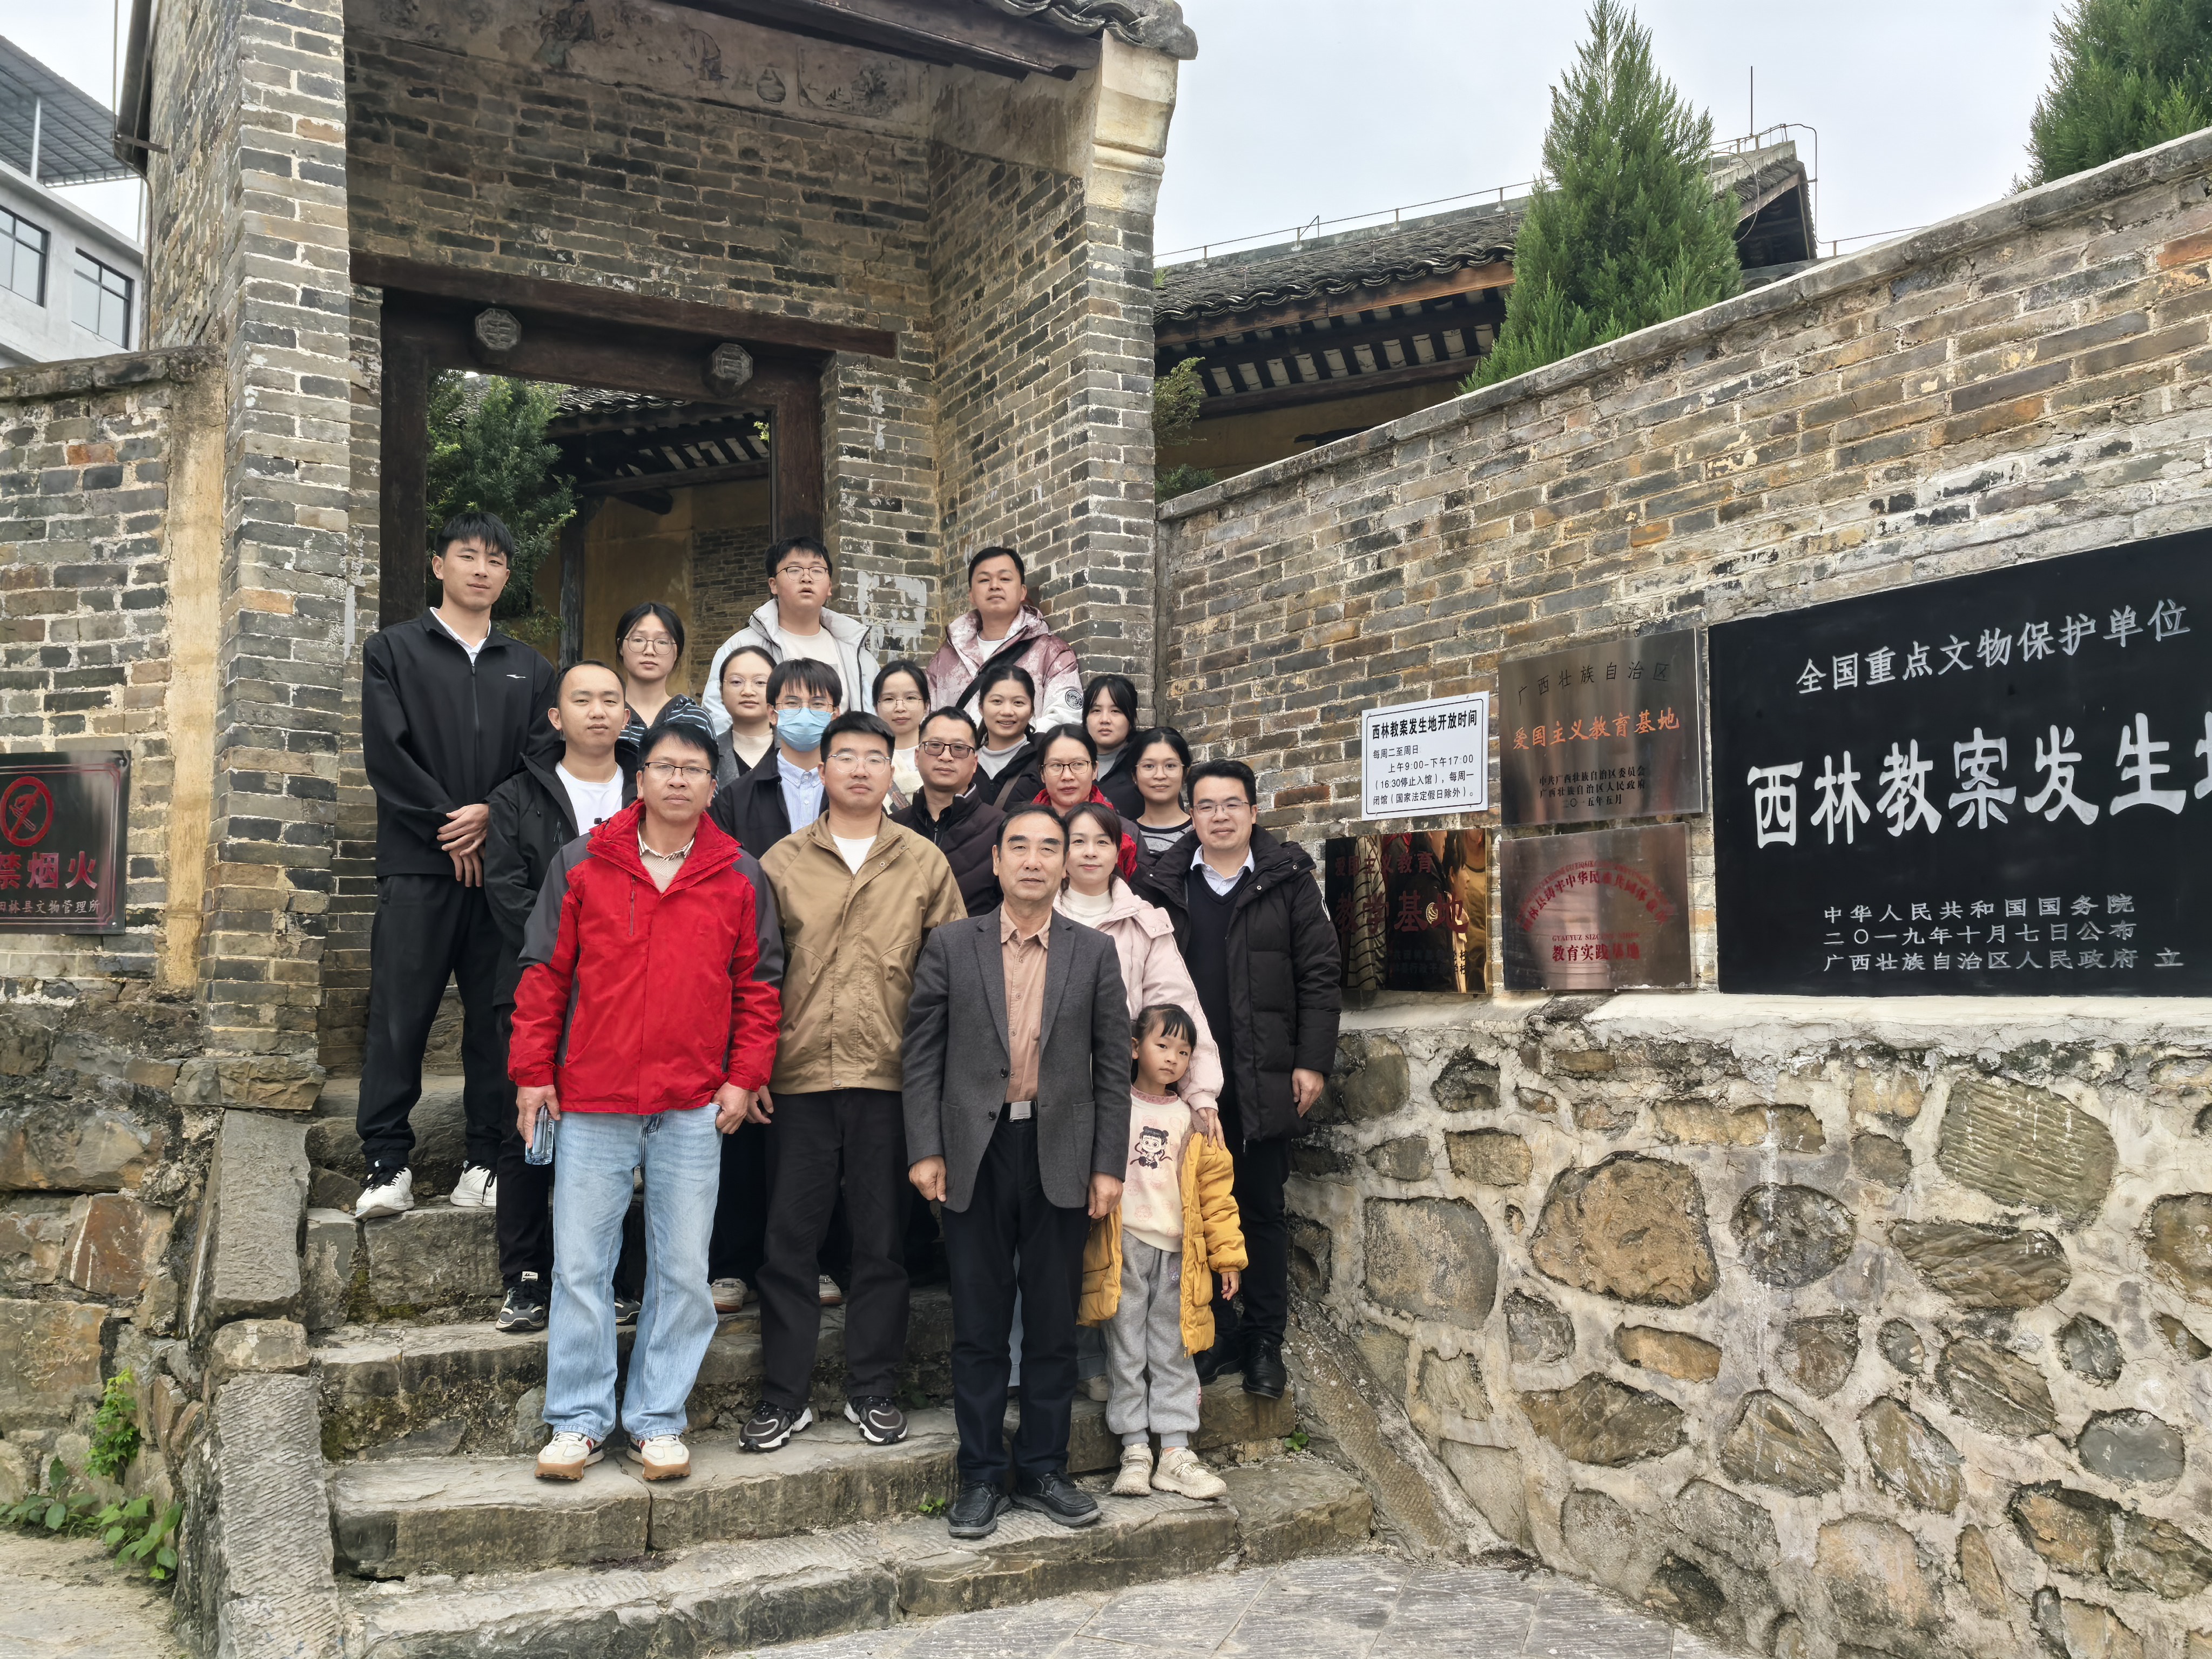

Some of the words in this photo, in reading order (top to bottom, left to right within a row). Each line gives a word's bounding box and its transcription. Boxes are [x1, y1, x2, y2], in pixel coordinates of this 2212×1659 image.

[1796, 599, 2190, 694] 全国重点文物保护单位
[1518, 660, 1670, 706] 广西壮族自治区
[1372, 710, 1477, 739] 西林教案发生地开放时间
[1513, 707, 1680, 750] 爱国主义教育基地
[1540, 765, 1646, 786] 中共广西壮族自治区委员会
[1540, 779, 1646, 799] 广西壮族自治区人民政府
[1746, 711, 2212, 848] 西林教案发生
[1336, 851, 1434, 876] 爱国主义教育
[1335, 890, 1469, 934] 教学基地
[1824, 893, 2135, 923] 中华人民共和国国务院
[1823, 948, 2139, 972] 广西壮族自治区人民政府
[2154, 947, 2184, 968] 立
